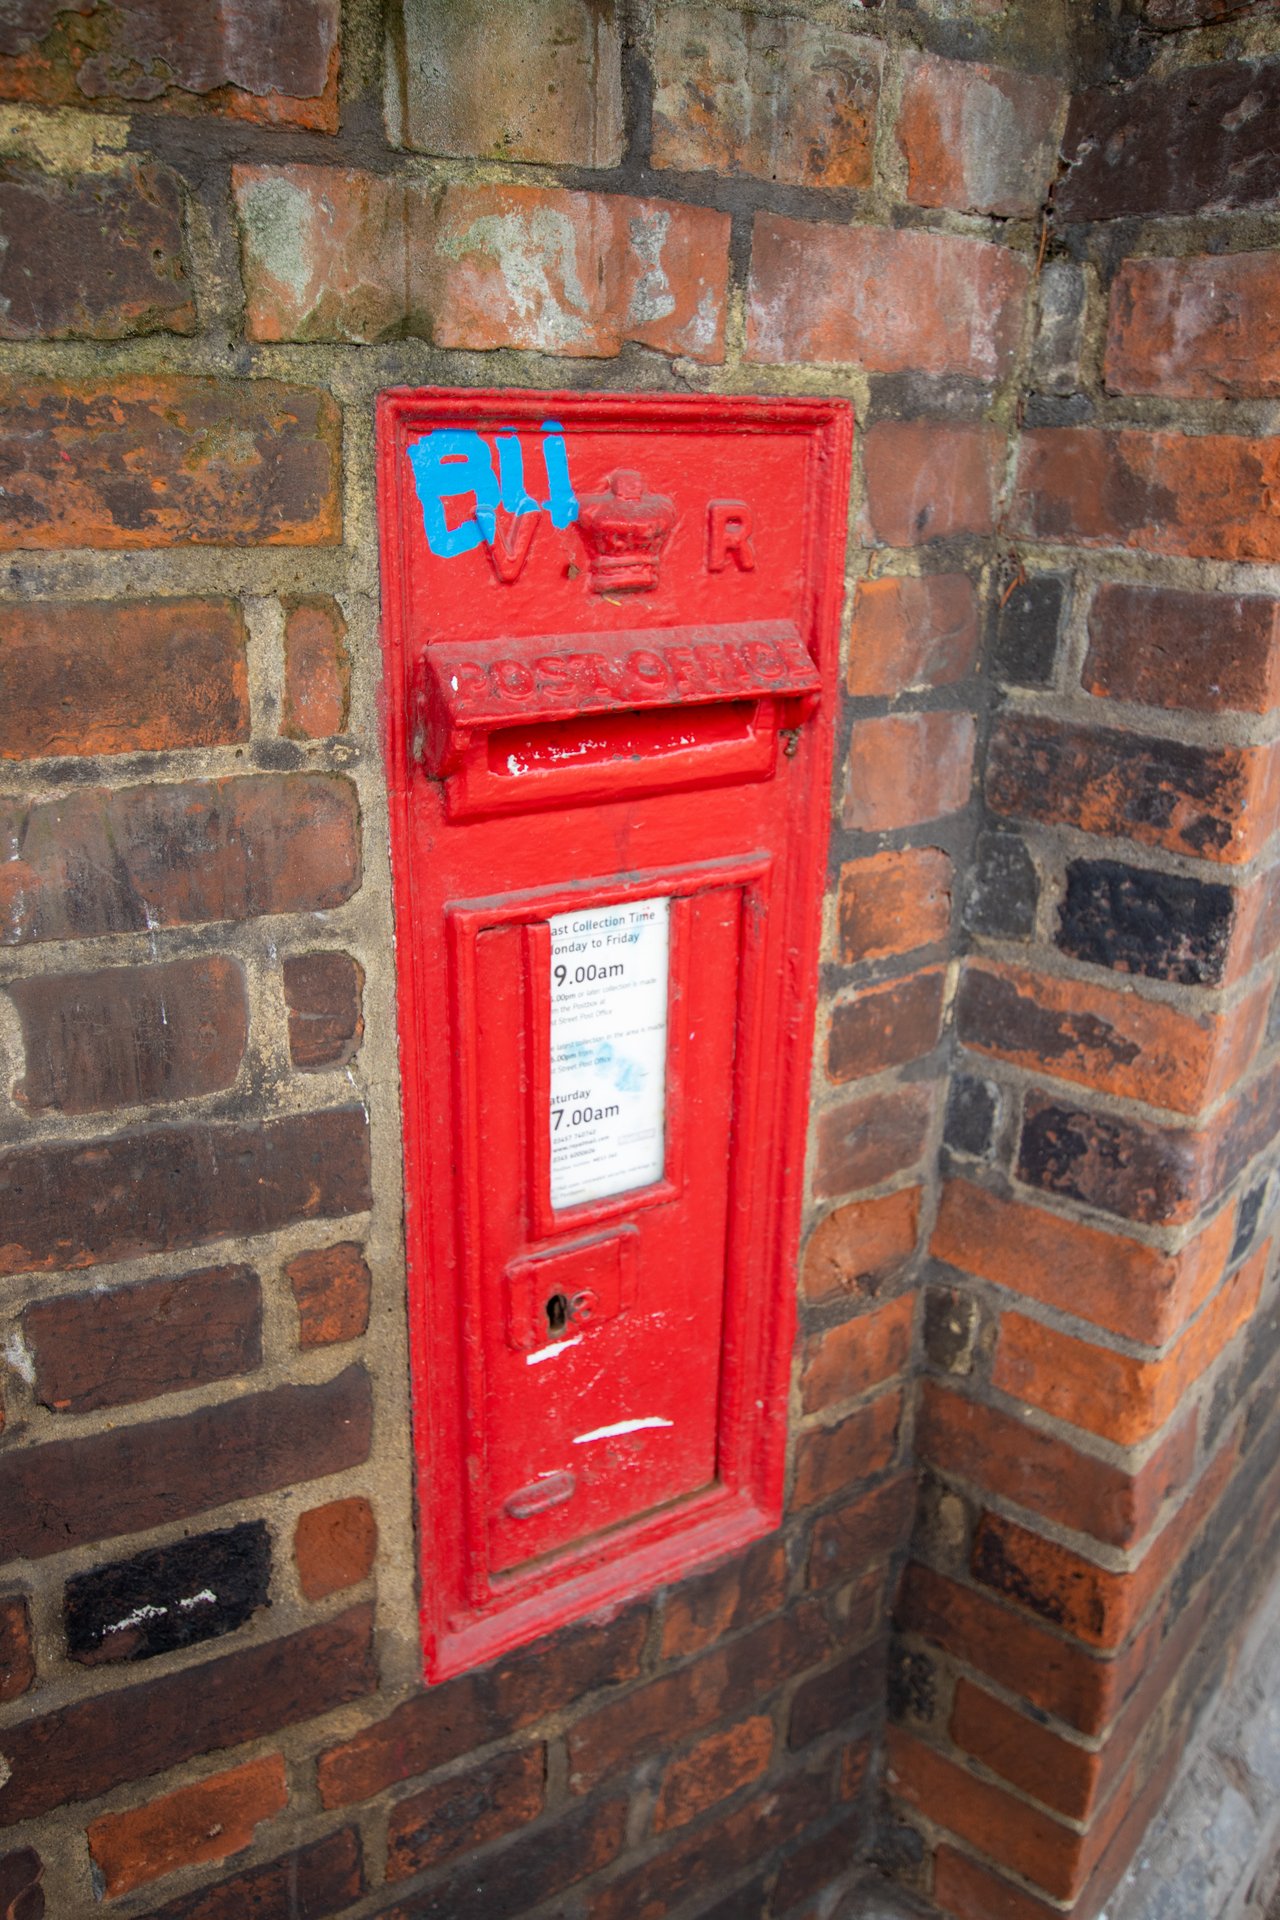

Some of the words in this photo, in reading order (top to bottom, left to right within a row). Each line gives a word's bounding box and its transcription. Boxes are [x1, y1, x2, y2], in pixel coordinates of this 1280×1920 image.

[474, 503, 542, 584] V
[706, 499, 756, 573] R
[453, 651, 612, 702] POST
[624, 638, 813, 699] OFFICE
[551, 925, 568, 937] ast
[572, 915, 626, 933] Collection
[629, 911, 656, 923] Time
[592, 939, 603, 949] to
[606, 932, 640, 946] Friday
[553, 963, 624, 988] 9.00am
[550, 1088, 592, 1106] aturday
[552, 1104, 620, 1131] 7.00am
